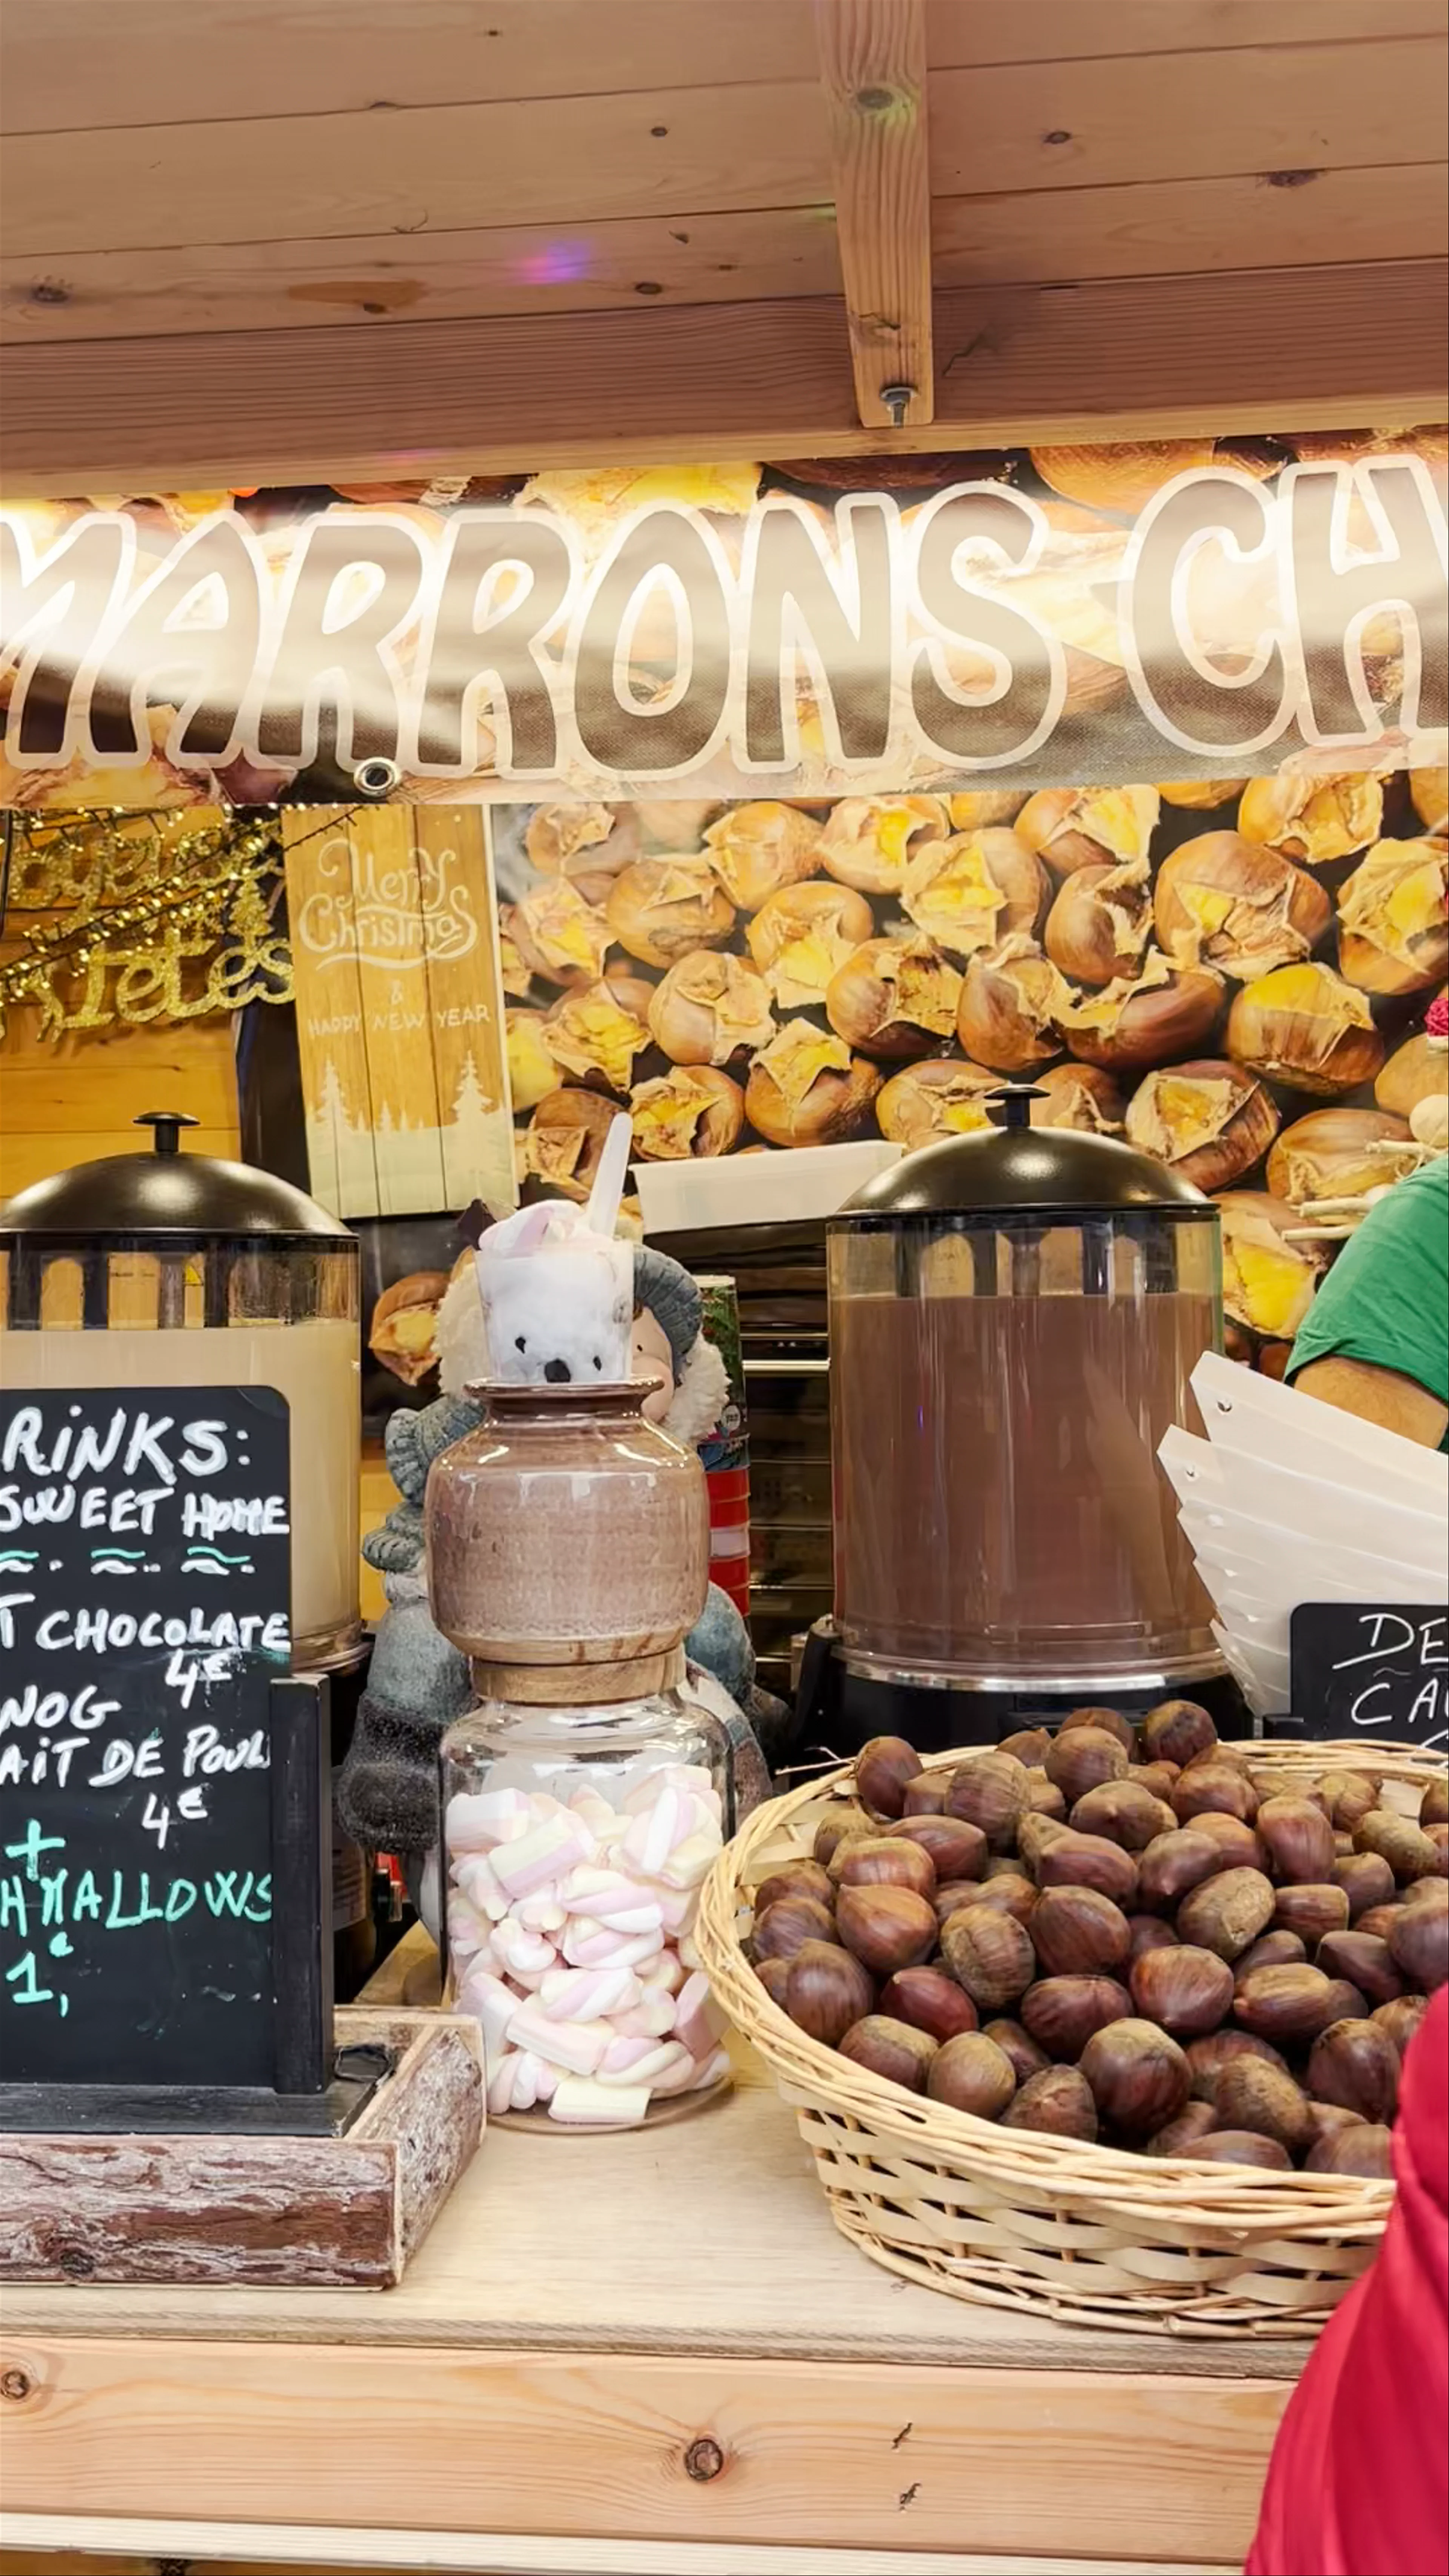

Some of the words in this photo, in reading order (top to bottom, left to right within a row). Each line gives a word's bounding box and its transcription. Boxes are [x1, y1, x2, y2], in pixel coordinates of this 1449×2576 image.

[318, 836, 456, 911] Merry
[299, 885, 477, 969] Christmas
[308, 1015, 362, 1039] HAPPY
[372, 1012, 424, 1032] NEW
[437, 1004, 490, 1029] YEAR
[0, 1484, 175, 1535] SWEET
[181, 1492, 290, 1541] HOME
[35, 1607, 291, 1653] CHOCOLATE
[0, 1684, 122, 1736] NOG
[89, 1737, 165, 1787] DE
[183, 1724, 271, 1777] POUL
